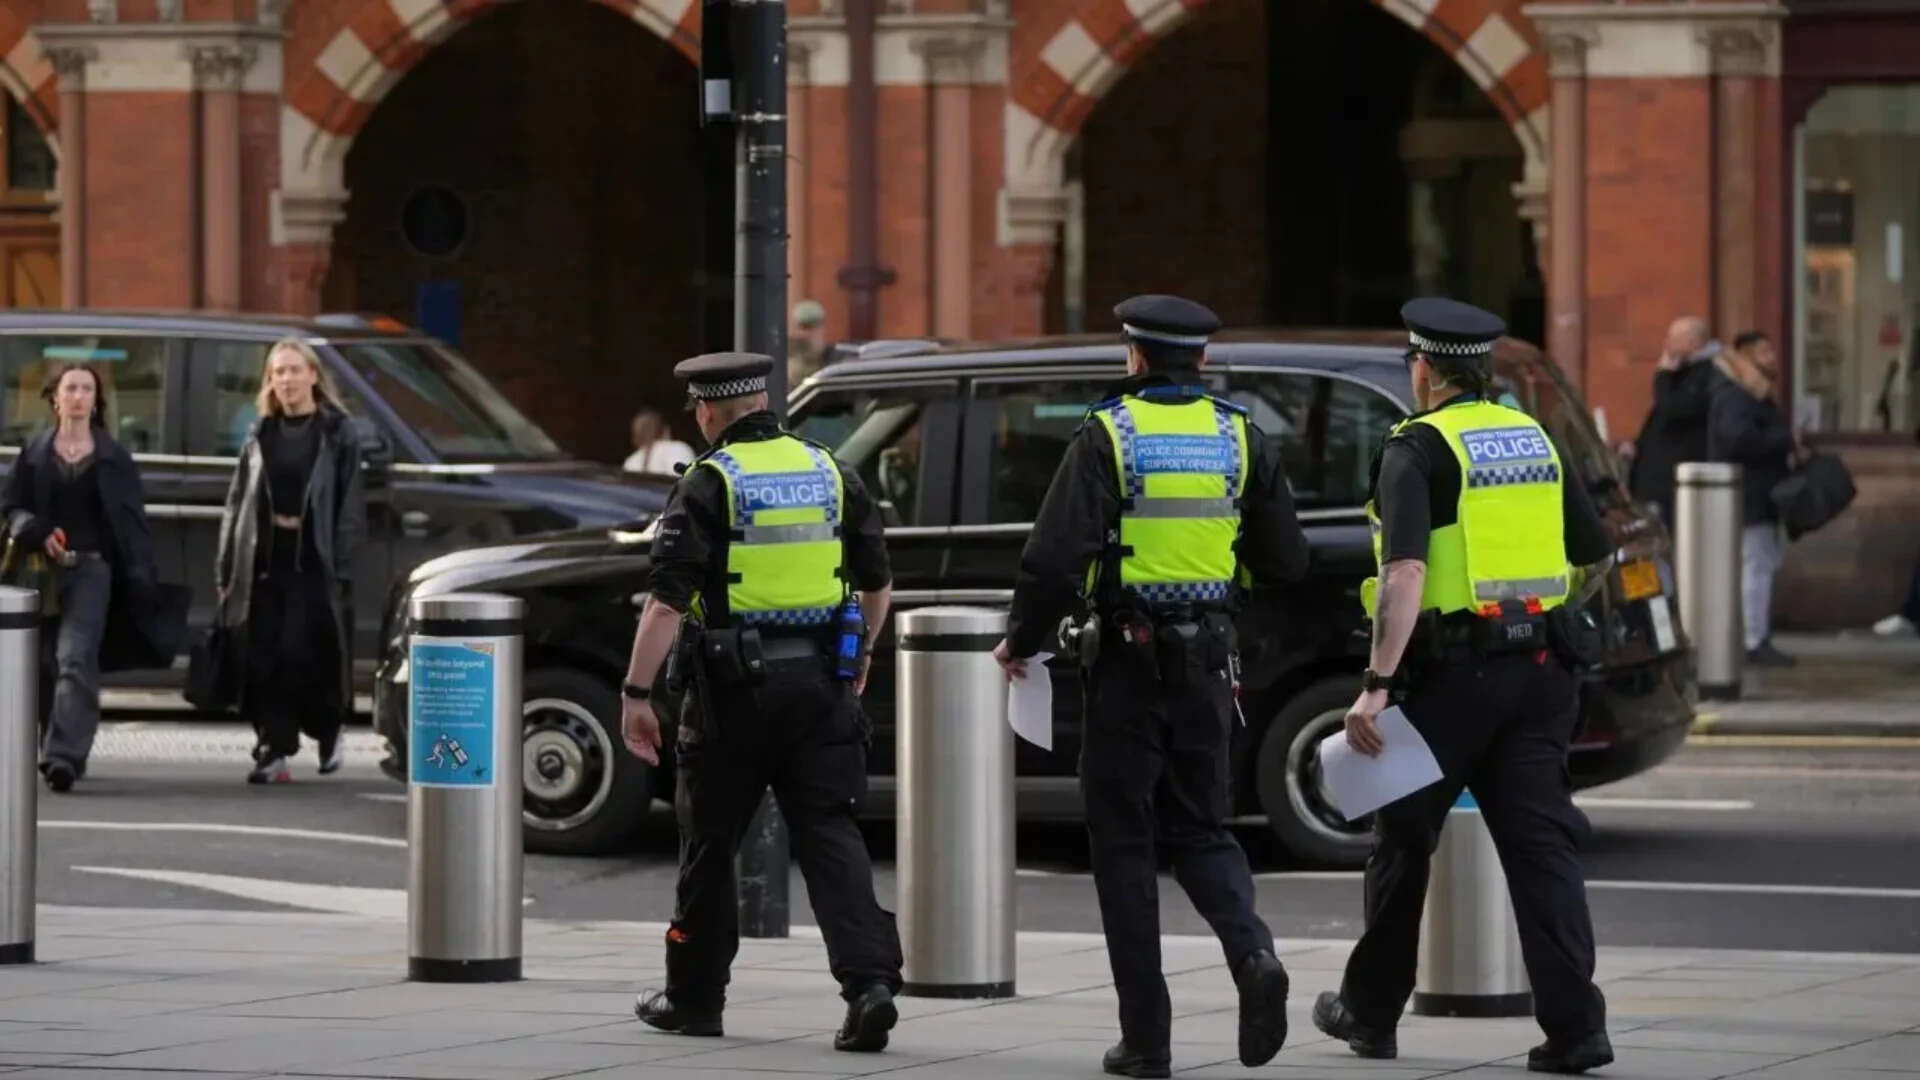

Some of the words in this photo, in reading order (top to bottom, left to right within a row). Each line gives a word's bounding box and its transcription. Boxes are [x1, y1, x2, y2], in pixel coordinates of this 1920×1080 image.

[1137, 446, 1171, 456] POLICE
[1174, 446, 1228, 457] COMMUNITY
[1467, 437, 1548, 461] POLICE
[1144, 459, 1186, 470] SUPPORT
[1188, 459, 1226, 470] OFFICER
[743, 483, 827, 507] POLICE
